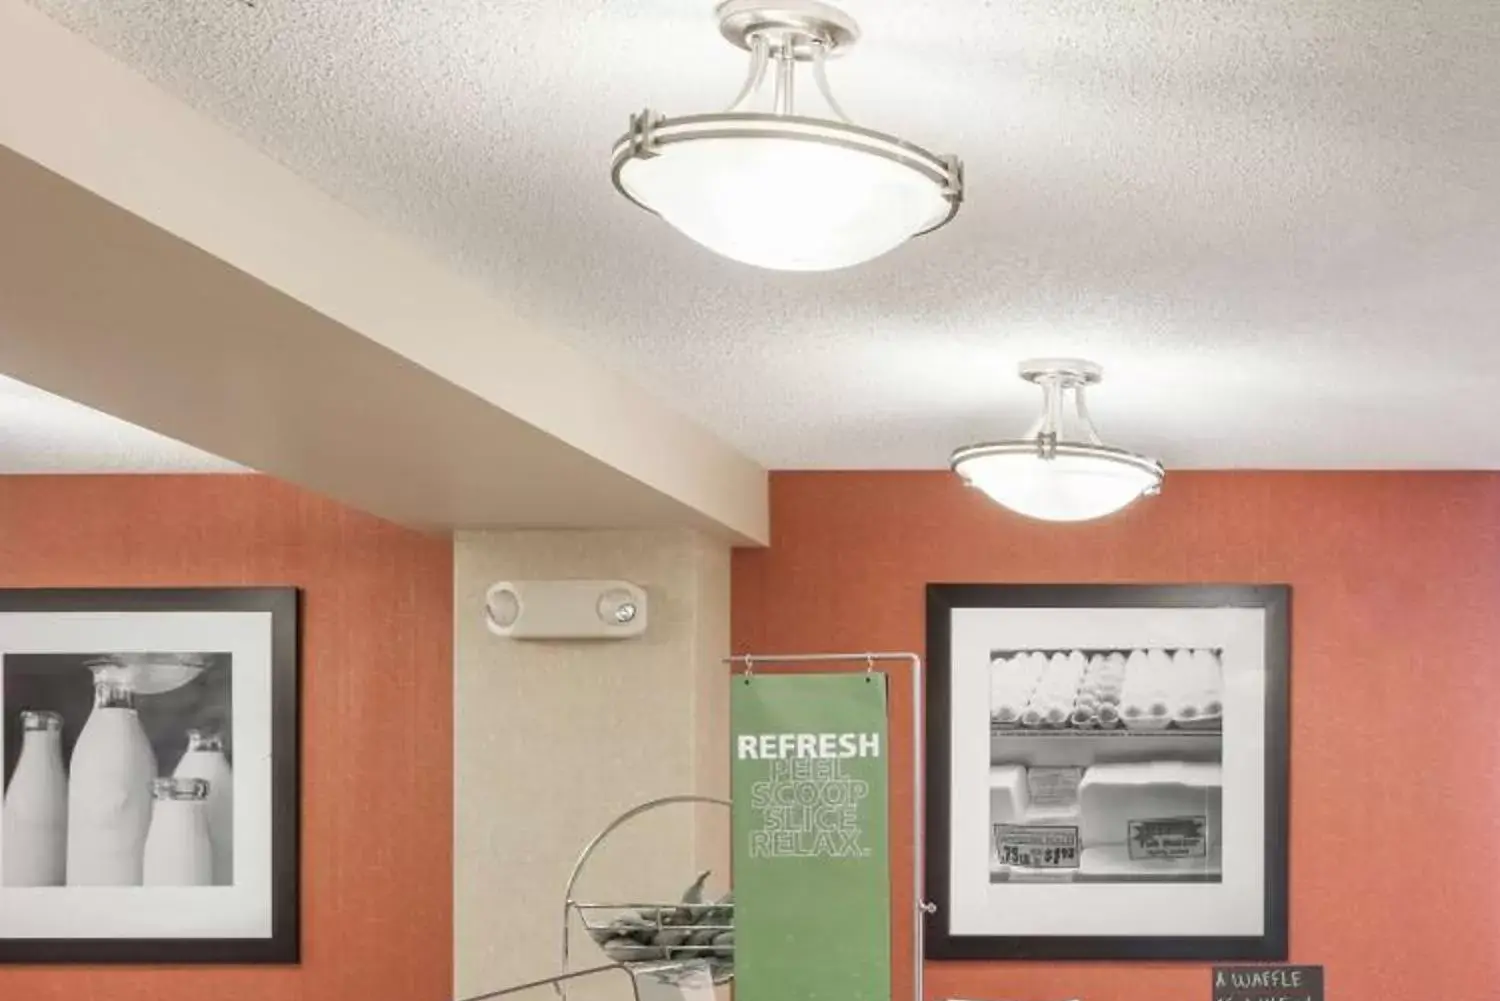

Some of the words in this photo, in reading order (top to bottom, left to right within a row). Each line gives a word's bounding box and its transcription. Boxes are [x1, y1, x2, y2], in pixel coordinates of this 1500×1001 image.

[737, 733, 880, 759] REFRESH
[769, 756, 851, 782] PEEL
[750, 779, 870, 808] SCOOP
[763, 803, 858, 832] SLICE
[1216, 970, 1227, 988] A
[1231, 969, 1302, 989] WAFFLE
